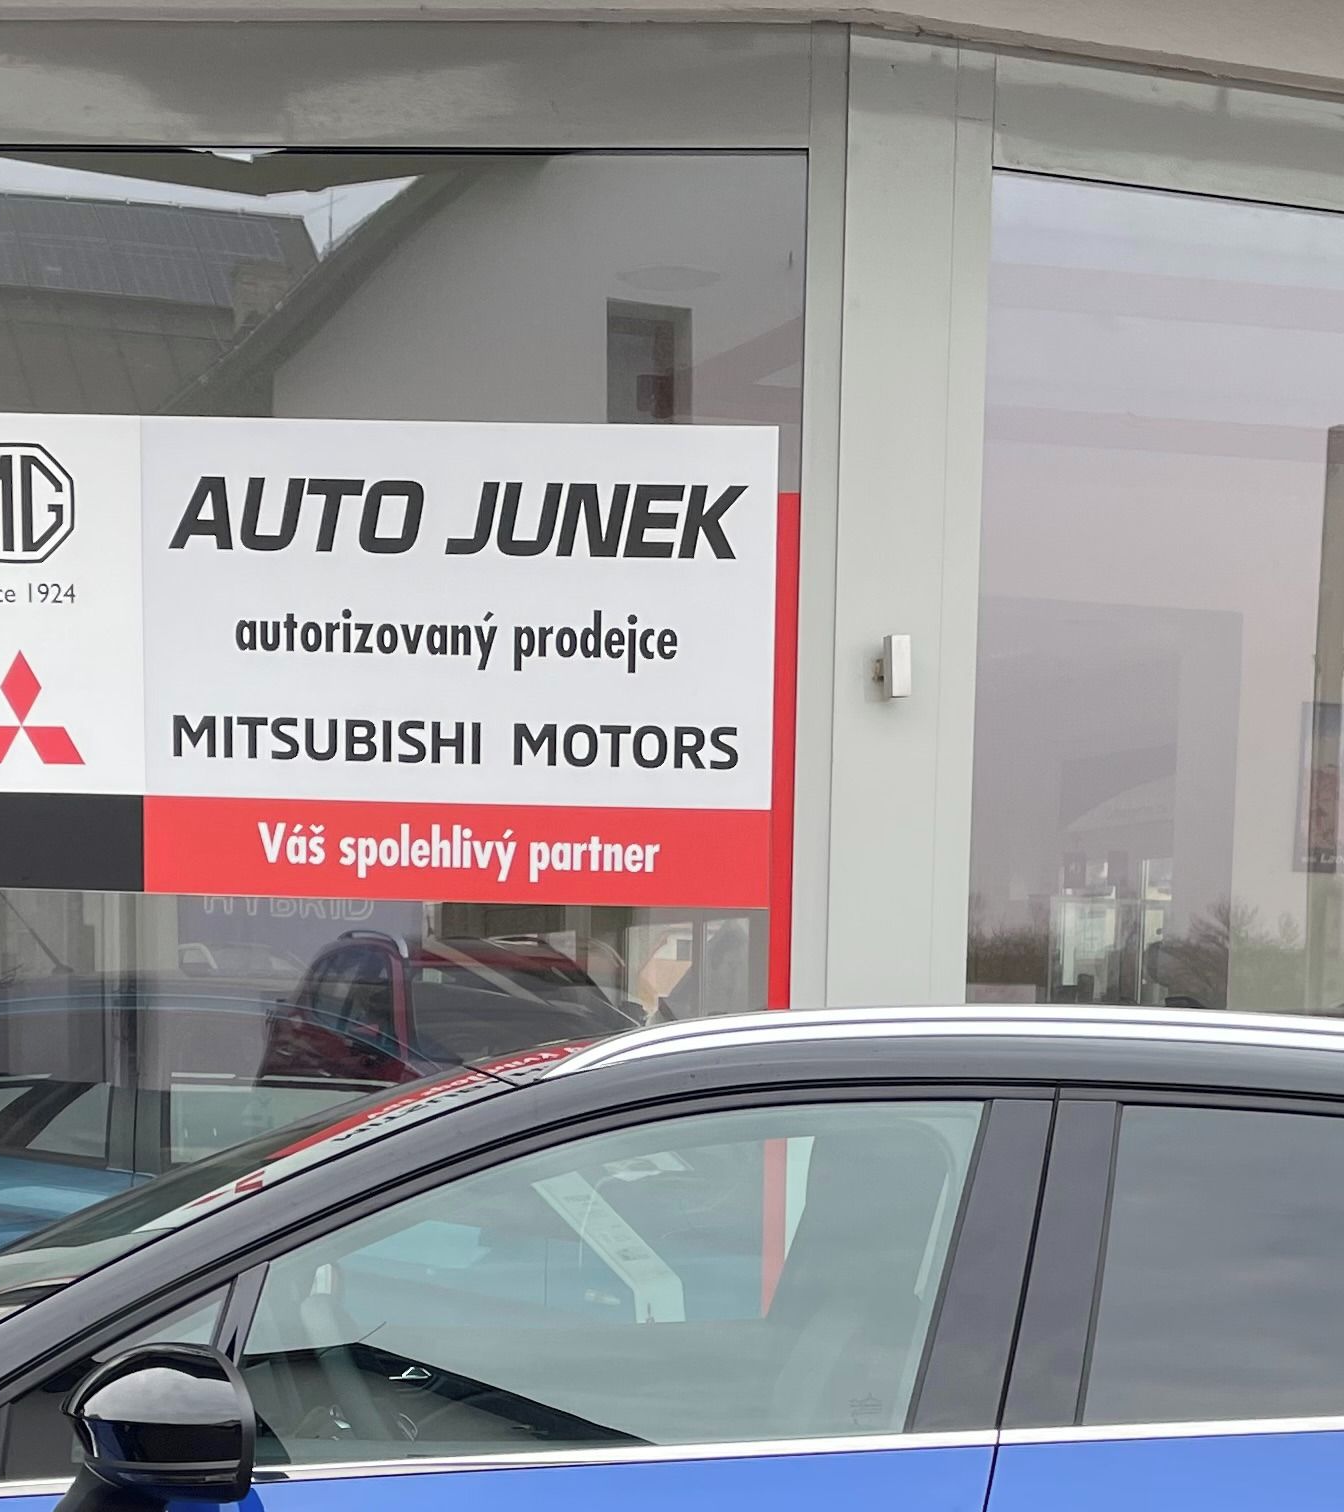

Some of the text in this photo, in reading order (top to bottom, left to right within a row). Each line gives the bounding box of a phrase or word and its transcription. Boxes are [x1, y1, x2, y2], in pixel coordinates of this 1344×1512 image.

[169, 476, 749, 560] AUTO JUNEK
[28, 583, 76, 604] 1924
[235, 608, 678, 674] autorizovaný prodejce
[172, 714, 739, 770] MITSUBISHI MOTORS
[257, 822, 660, 884] Váš spolehlivý partner
